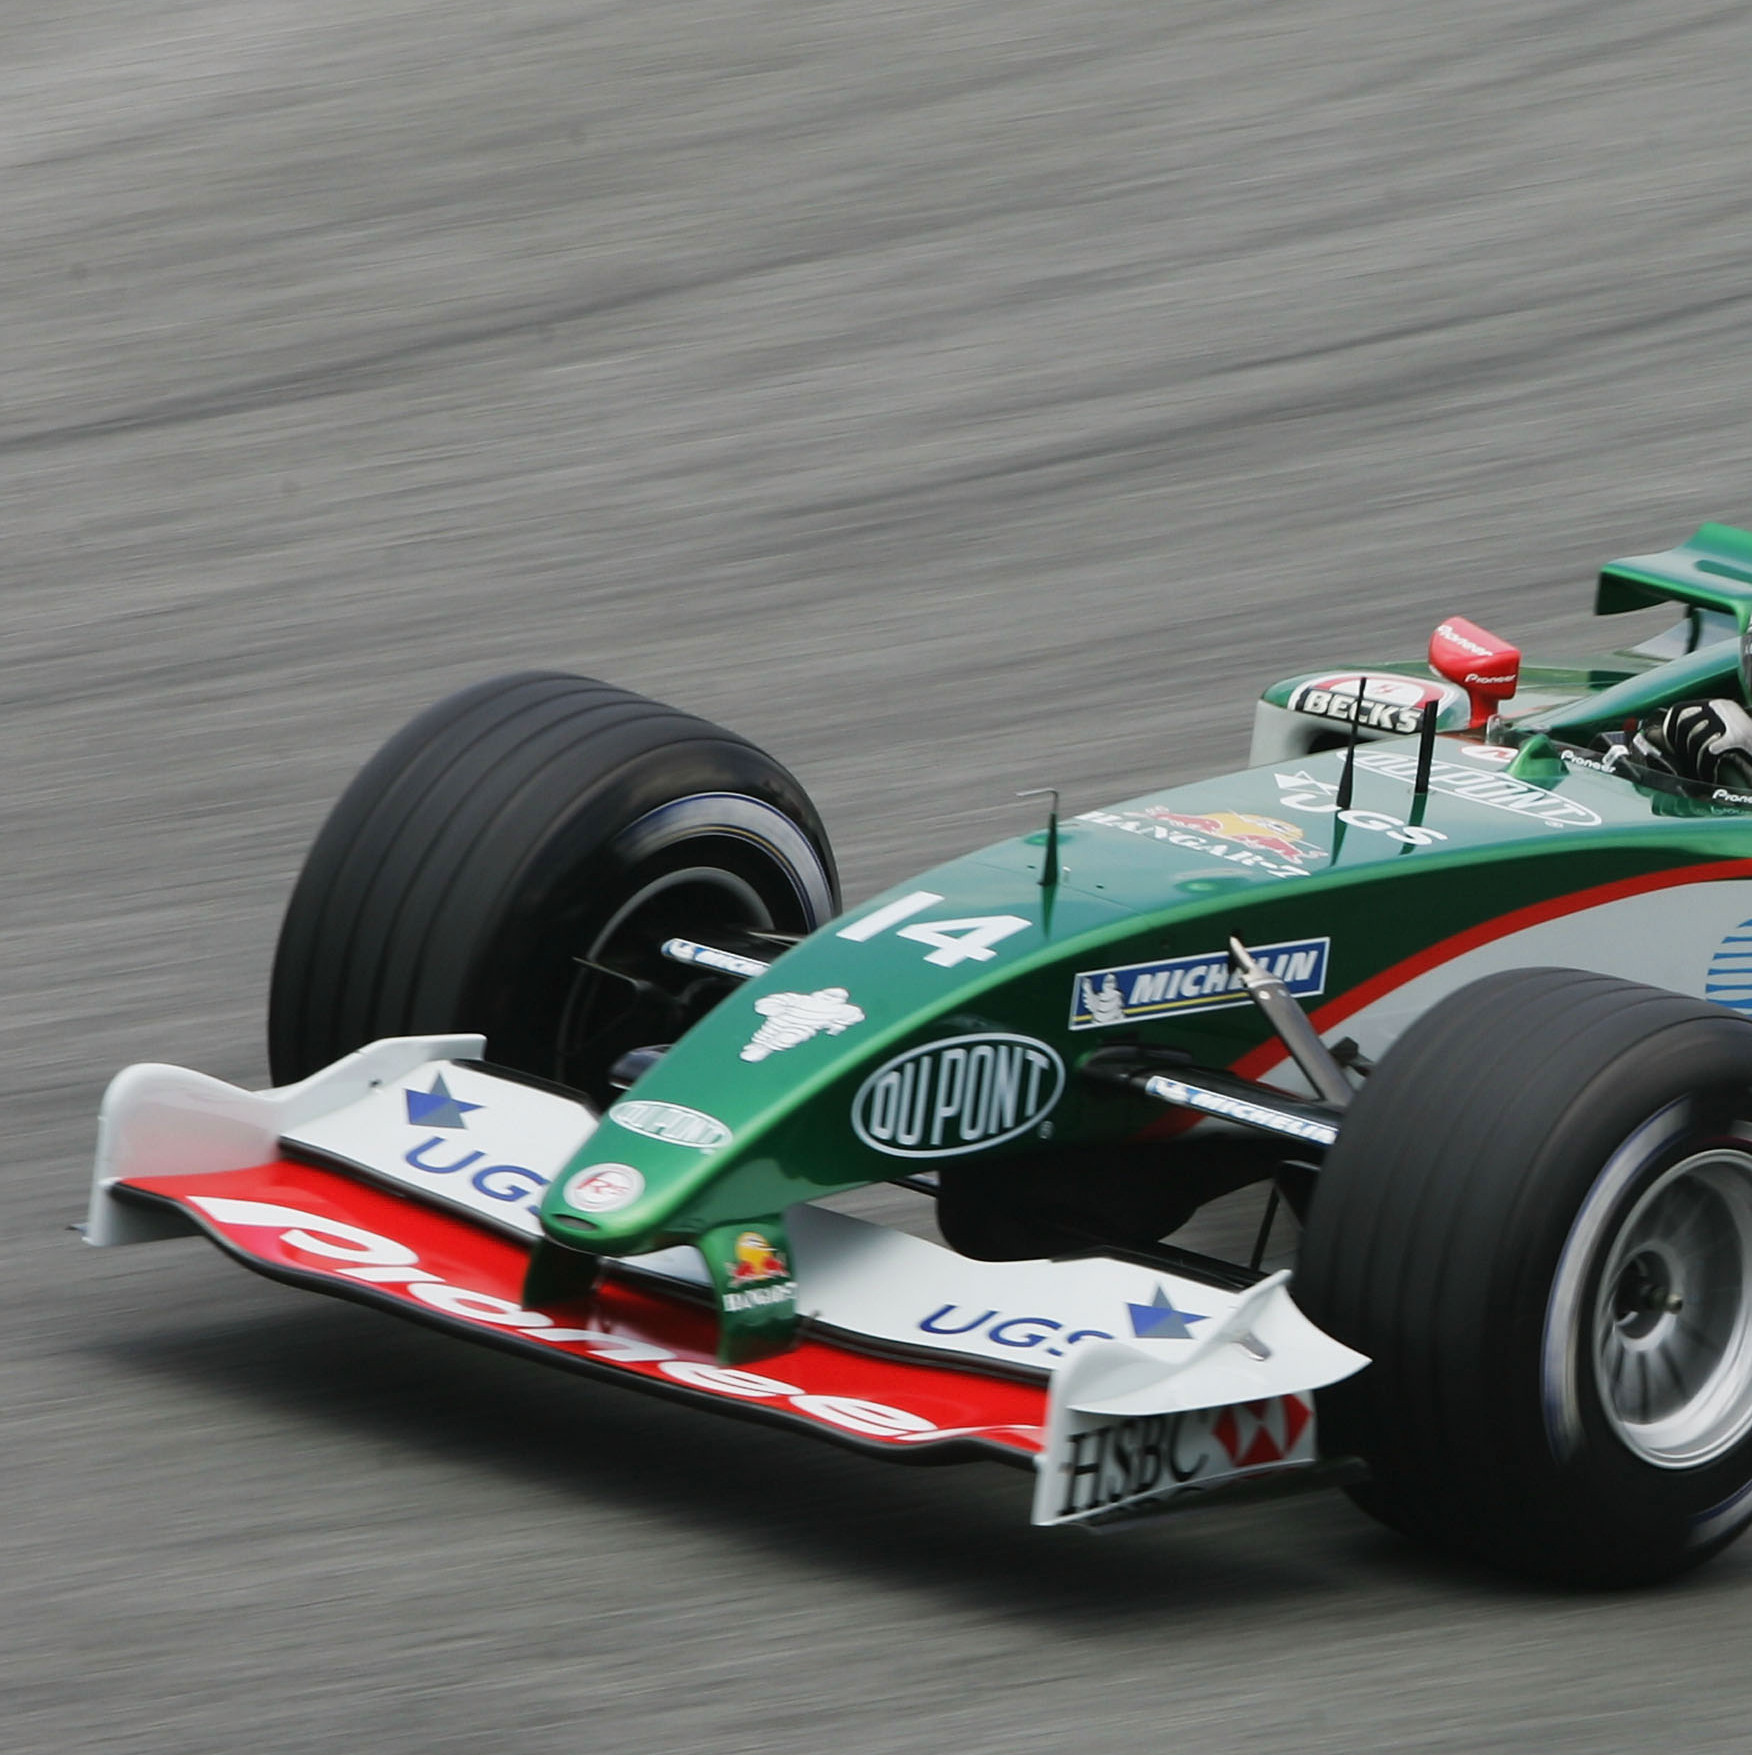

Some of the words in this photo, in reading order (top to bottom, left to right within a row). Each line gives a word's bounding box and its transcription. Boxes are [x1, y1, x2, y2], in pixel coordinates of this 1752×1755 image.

[1464, 673, 1517, 685] Pioneer
[1073, 810, 1311, 878] HANGAR-7
[1280, 792, 1448, 846] UGS
[836, 890, 1032, 967] 14
[405, 1137, 550, 1214] UG
[185, 1195, 1045, 1442] Pioneer
[1058, 1406, 1211, 1517] HSBC
